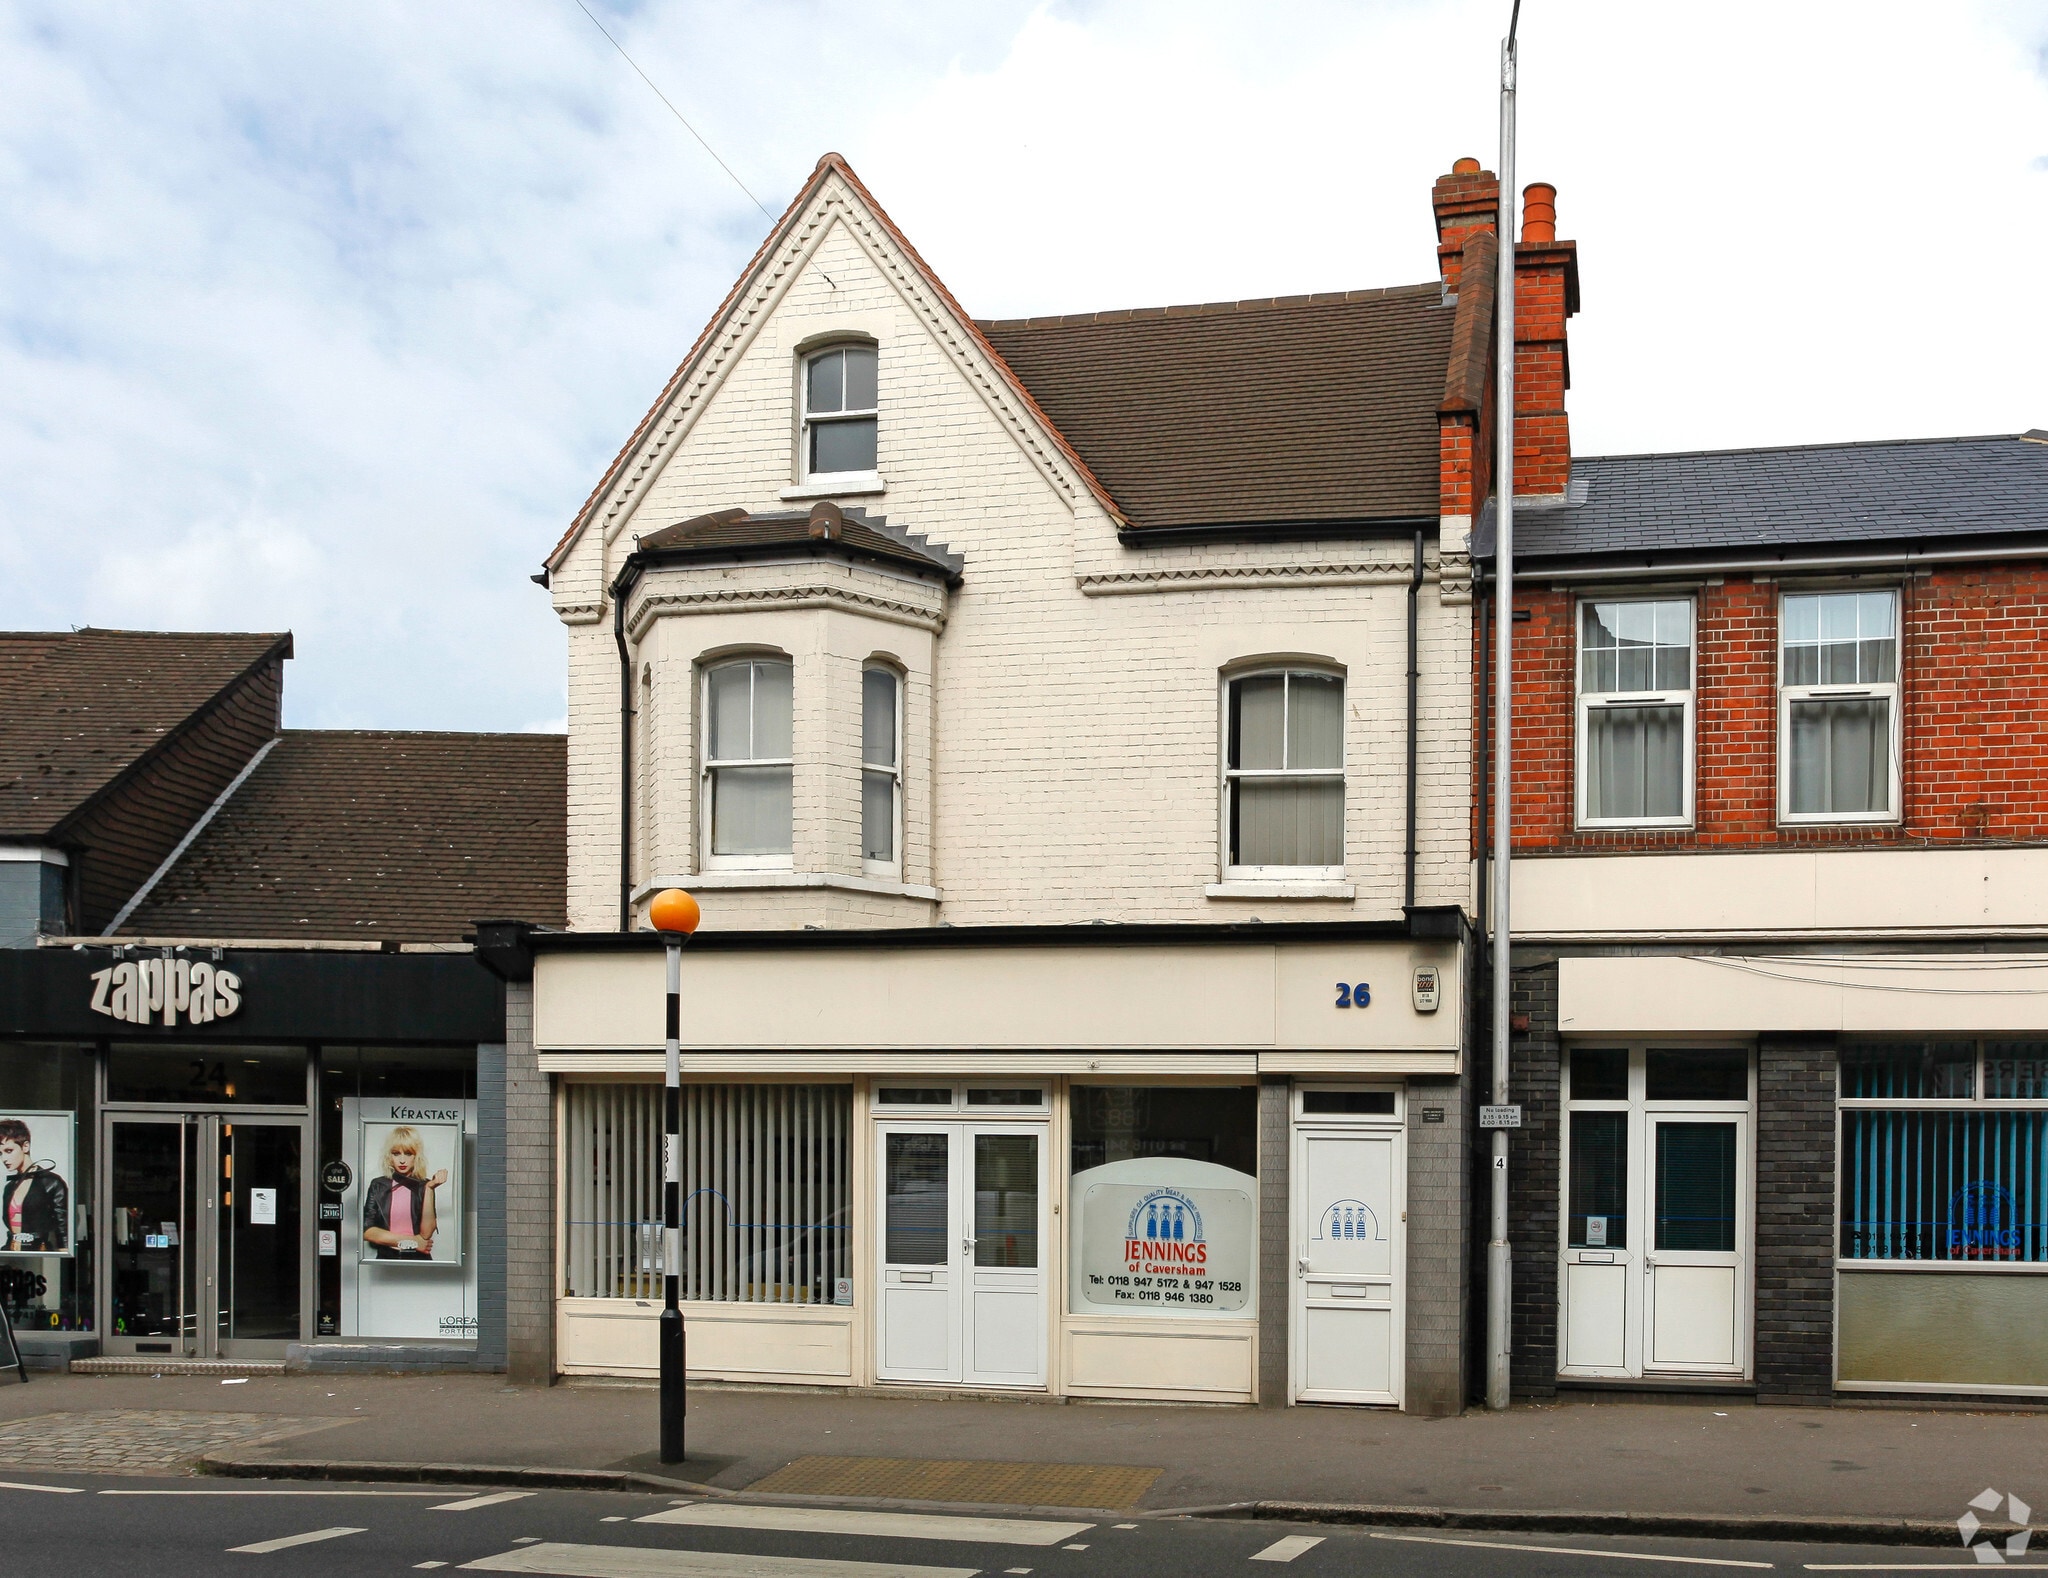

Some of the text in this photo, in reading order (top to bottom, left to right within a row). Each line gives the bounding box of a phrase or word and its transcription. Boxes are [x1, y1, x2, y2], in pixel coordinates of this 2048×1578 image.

[1417, 974, 1434, 982] bond
[90, 958, 242, 1026] zappas
[1335, 982, 1371, 1008] 26
[190, 1061, 227, 1086] 24
[1496, 1157, 1504, 1169] 4
[327, 1175, 346, 1183] SALE
[323, 1209, 340, 1217] 2016
[1945, 1229, 2021, 1248] JENNINGS
[1124, 1240, 1207, 1263] JENNINGS
[1950, 1245, 2021, 1256] of Caversham
[1128, 1261, 1206, 1276] of Caversham
[1089, 1274, 1242, 1292] Tel: 0118 947 5172 & 947 1528
[1115, 1289, 1214, 1304] Fax: 0118 946 1380
